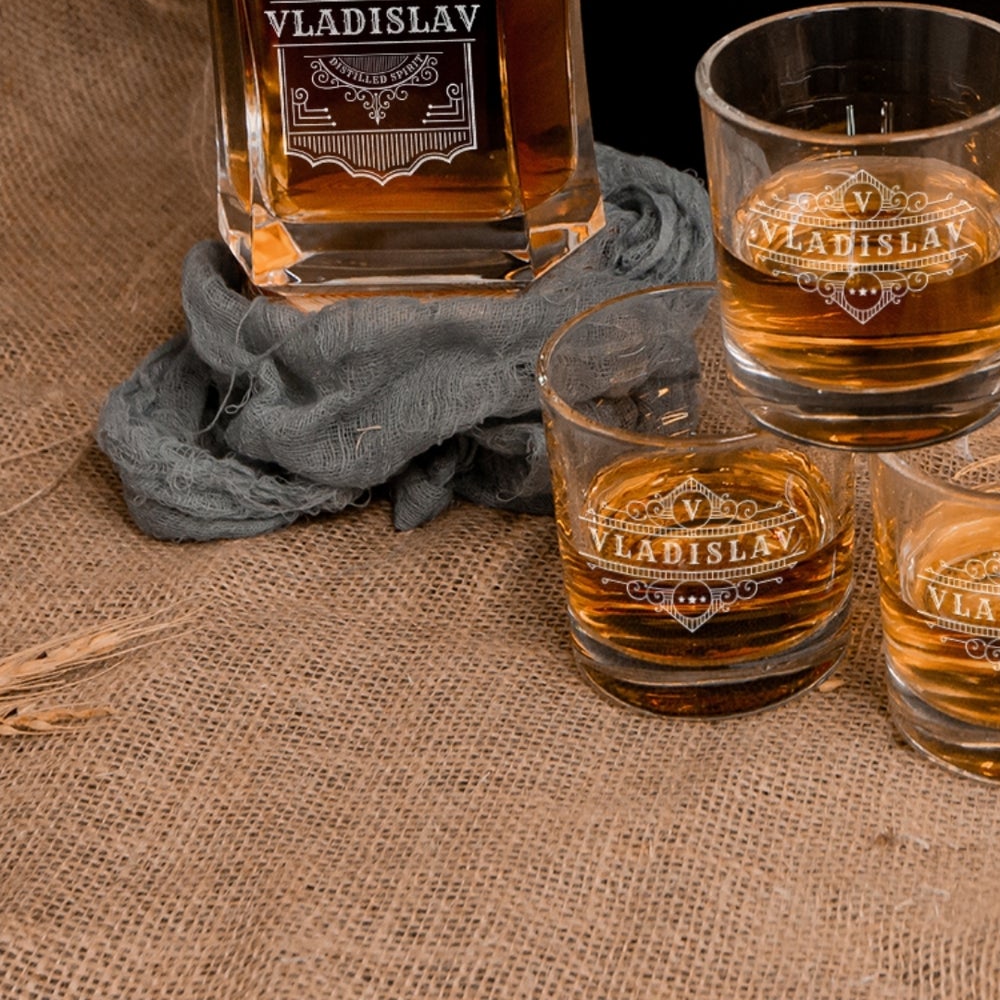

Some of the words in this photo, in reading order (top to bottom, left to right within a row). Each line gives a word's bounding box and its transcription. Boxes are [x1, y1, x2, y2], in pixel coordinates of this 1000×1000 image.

[264, 4, 480, 38] VLADISLAV
[329, 57, 387, 85] DISTILLED
[390, 53, 424, 82] SPIRIT
[853, 191, 872, 213] V
[760, 218, 966, 257] VLADISLAV
[682, 500, 702, 520] V
[589, 526, 795, 565] VLADISLAV
